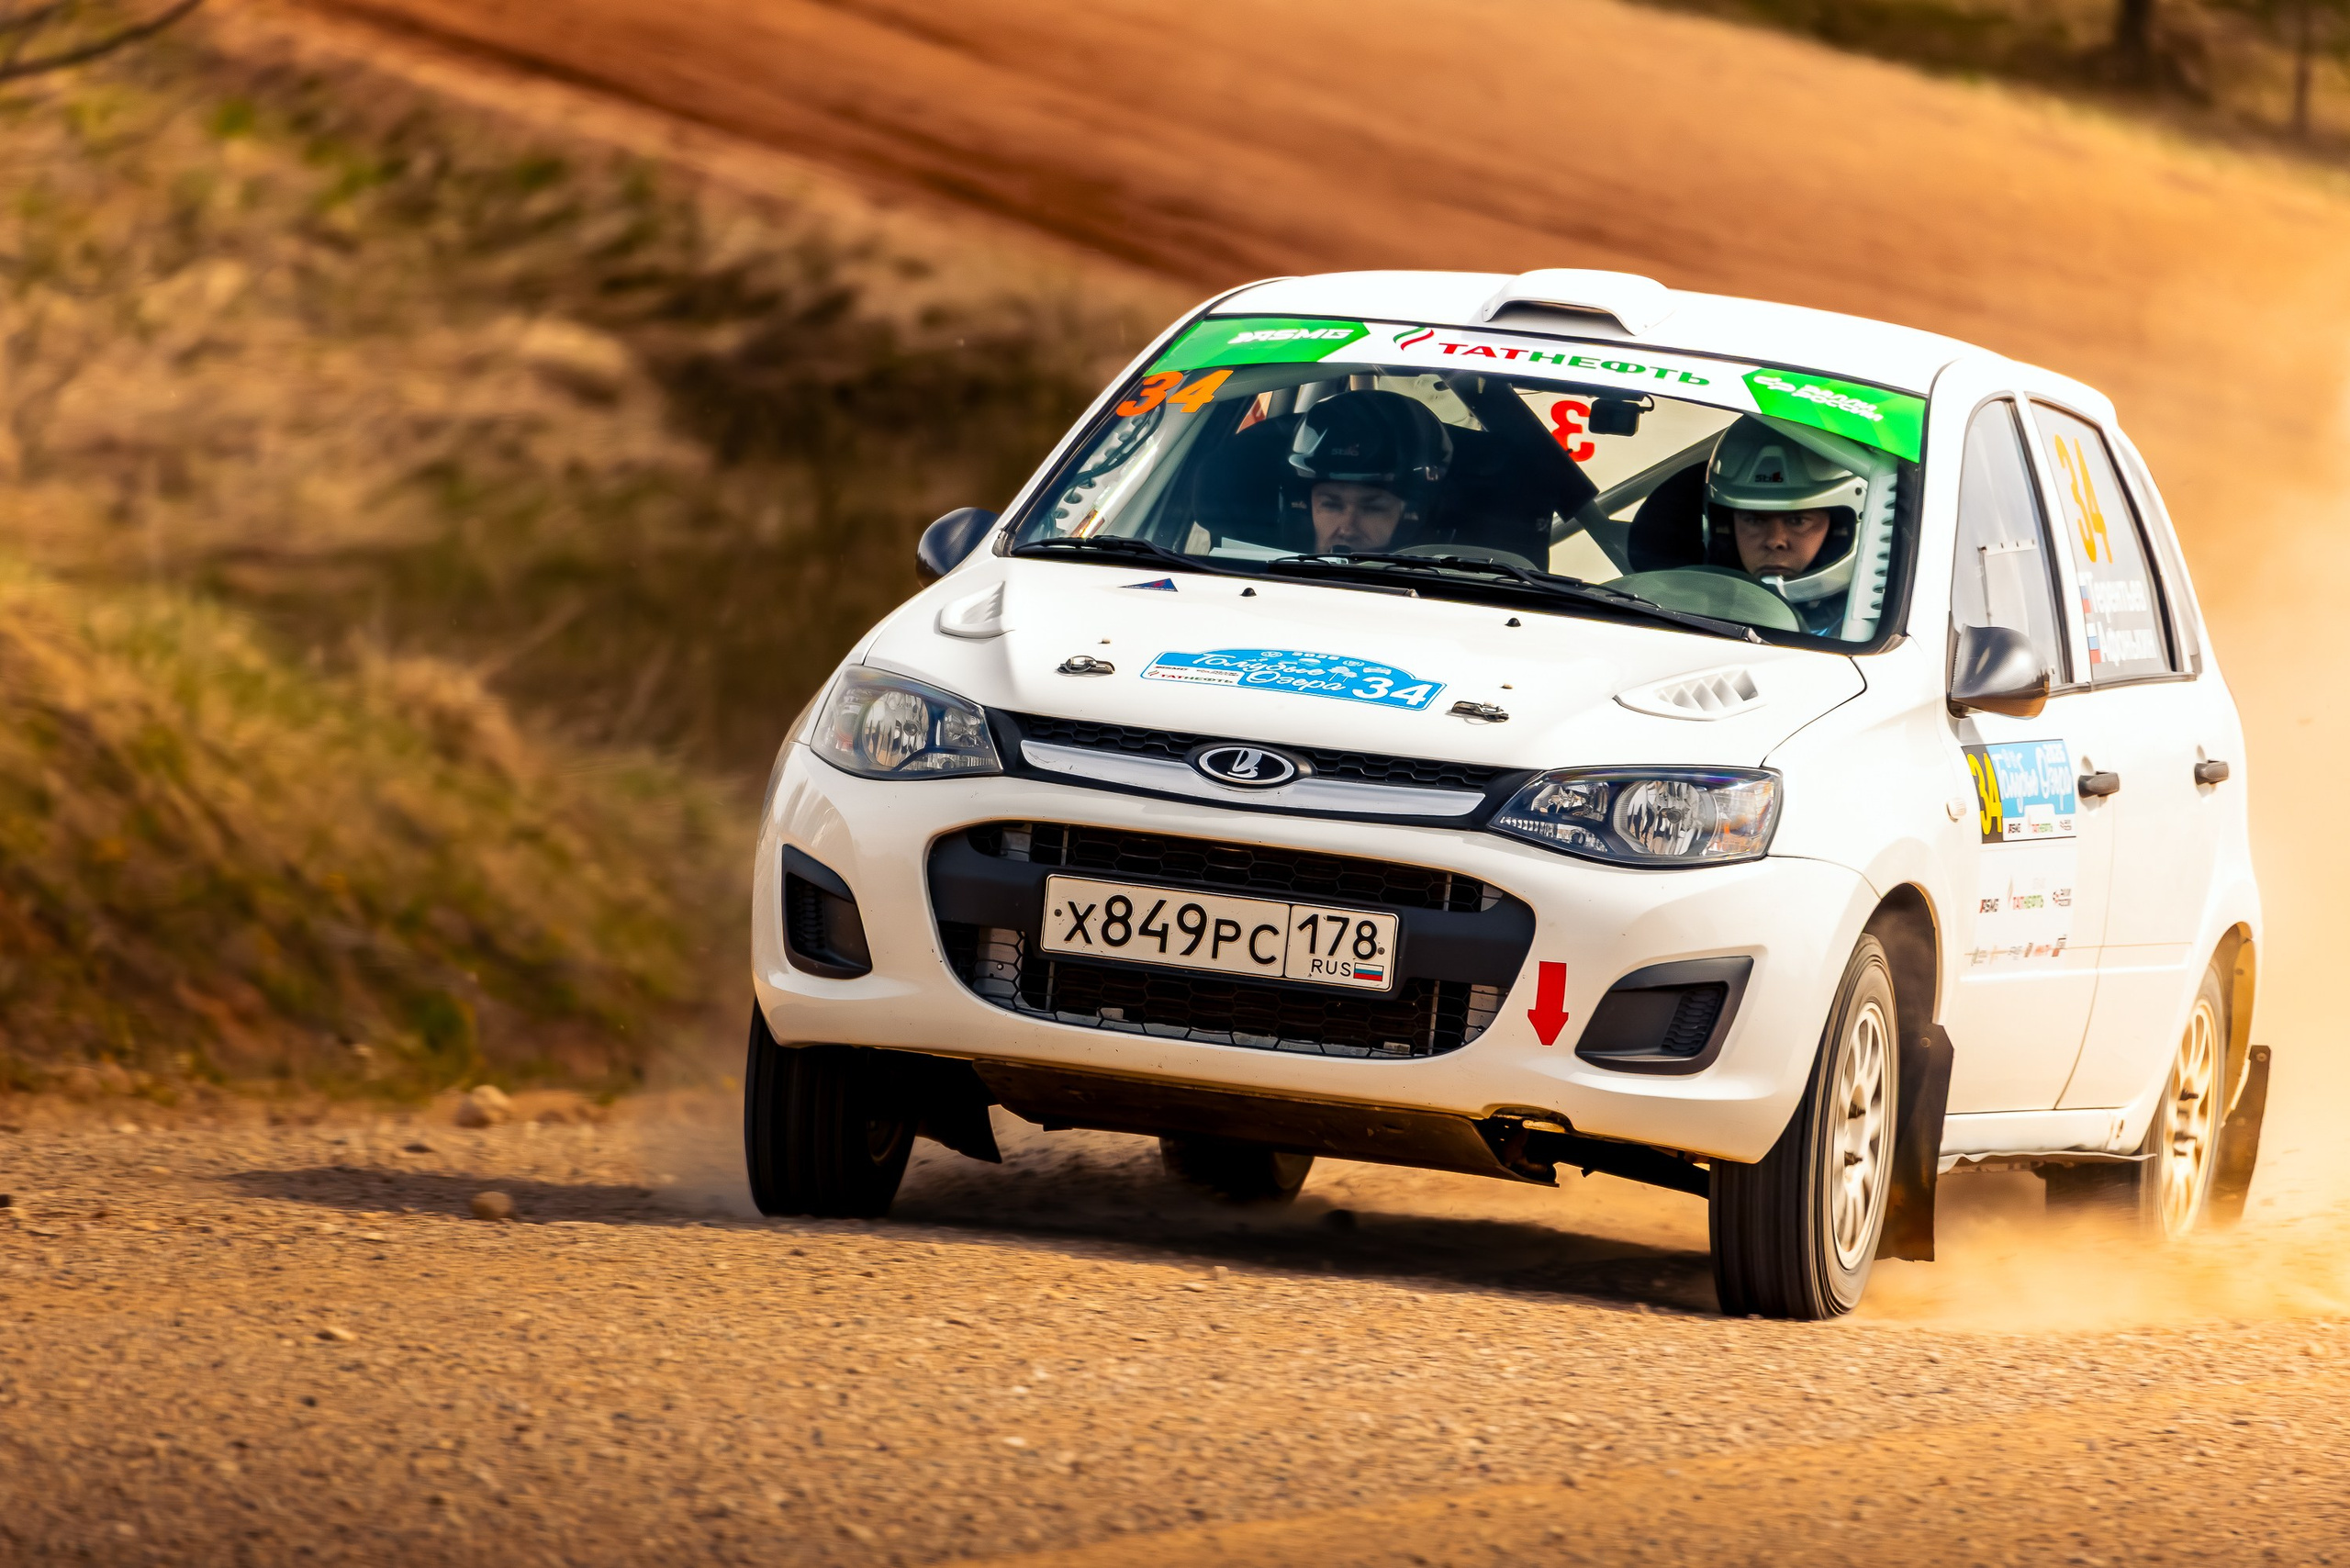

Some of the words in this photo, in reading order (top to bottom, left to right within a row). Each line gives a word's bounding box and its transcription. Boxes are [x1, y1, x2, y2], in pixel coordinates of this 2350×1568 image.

[1438, 342, 1710, 386] ТАТНЕФТЬ
[1115, 370, 1234, 417] 34
[2054, 434, 2112, 564] 34
[1161, 674, 1234, 684] ТАТНЕФТЬ
[1246, 670, 1346, 691] Озера
[1351, 677, 1434, 706] 34
[1967, 752, 2003, 835] 34
[1296, 913, 1378, 961] 178
[1310, 958, 1352, 978] RUS
